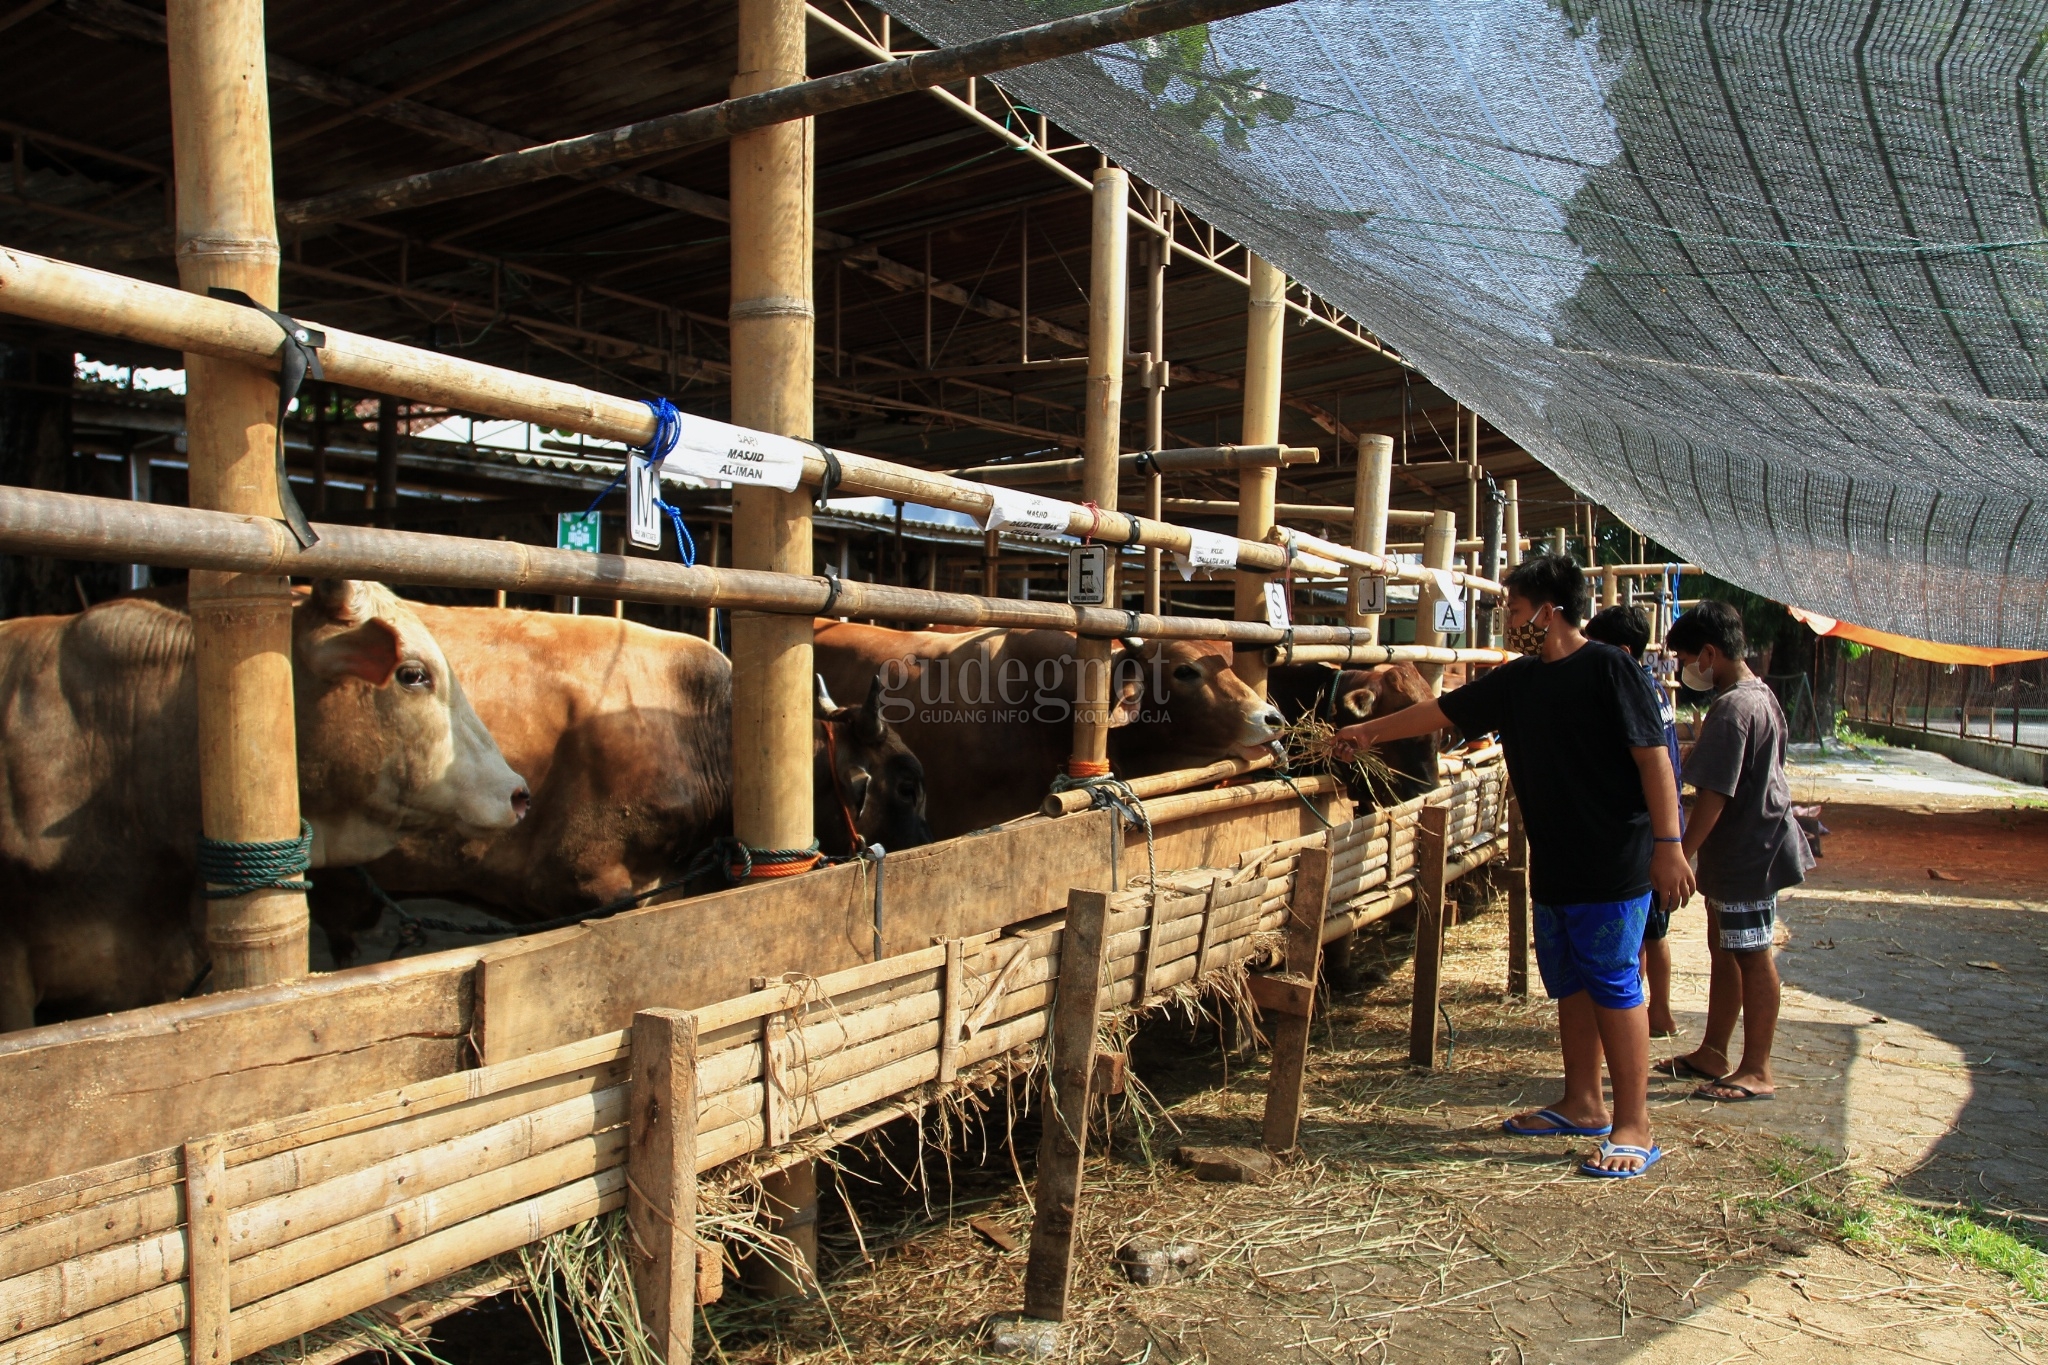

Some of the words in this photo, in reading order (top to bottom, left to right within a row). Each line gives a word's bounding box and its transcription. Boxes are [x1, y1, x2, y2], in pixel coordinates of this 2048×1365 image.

[727, 449, 764, 462] MASJID
[719, 465, 763, 479] AL-IMAN
[637, 467, 654, 529] M
[1080, 554, 1095, 593] E
[1271, 589, 1283, 619] S
[1367, 581, 1376, 607] J
[1441, 604, 1457, 626] A
[1647, 654, 1655, 665] O
[1661, 661, 1669, 671] N
